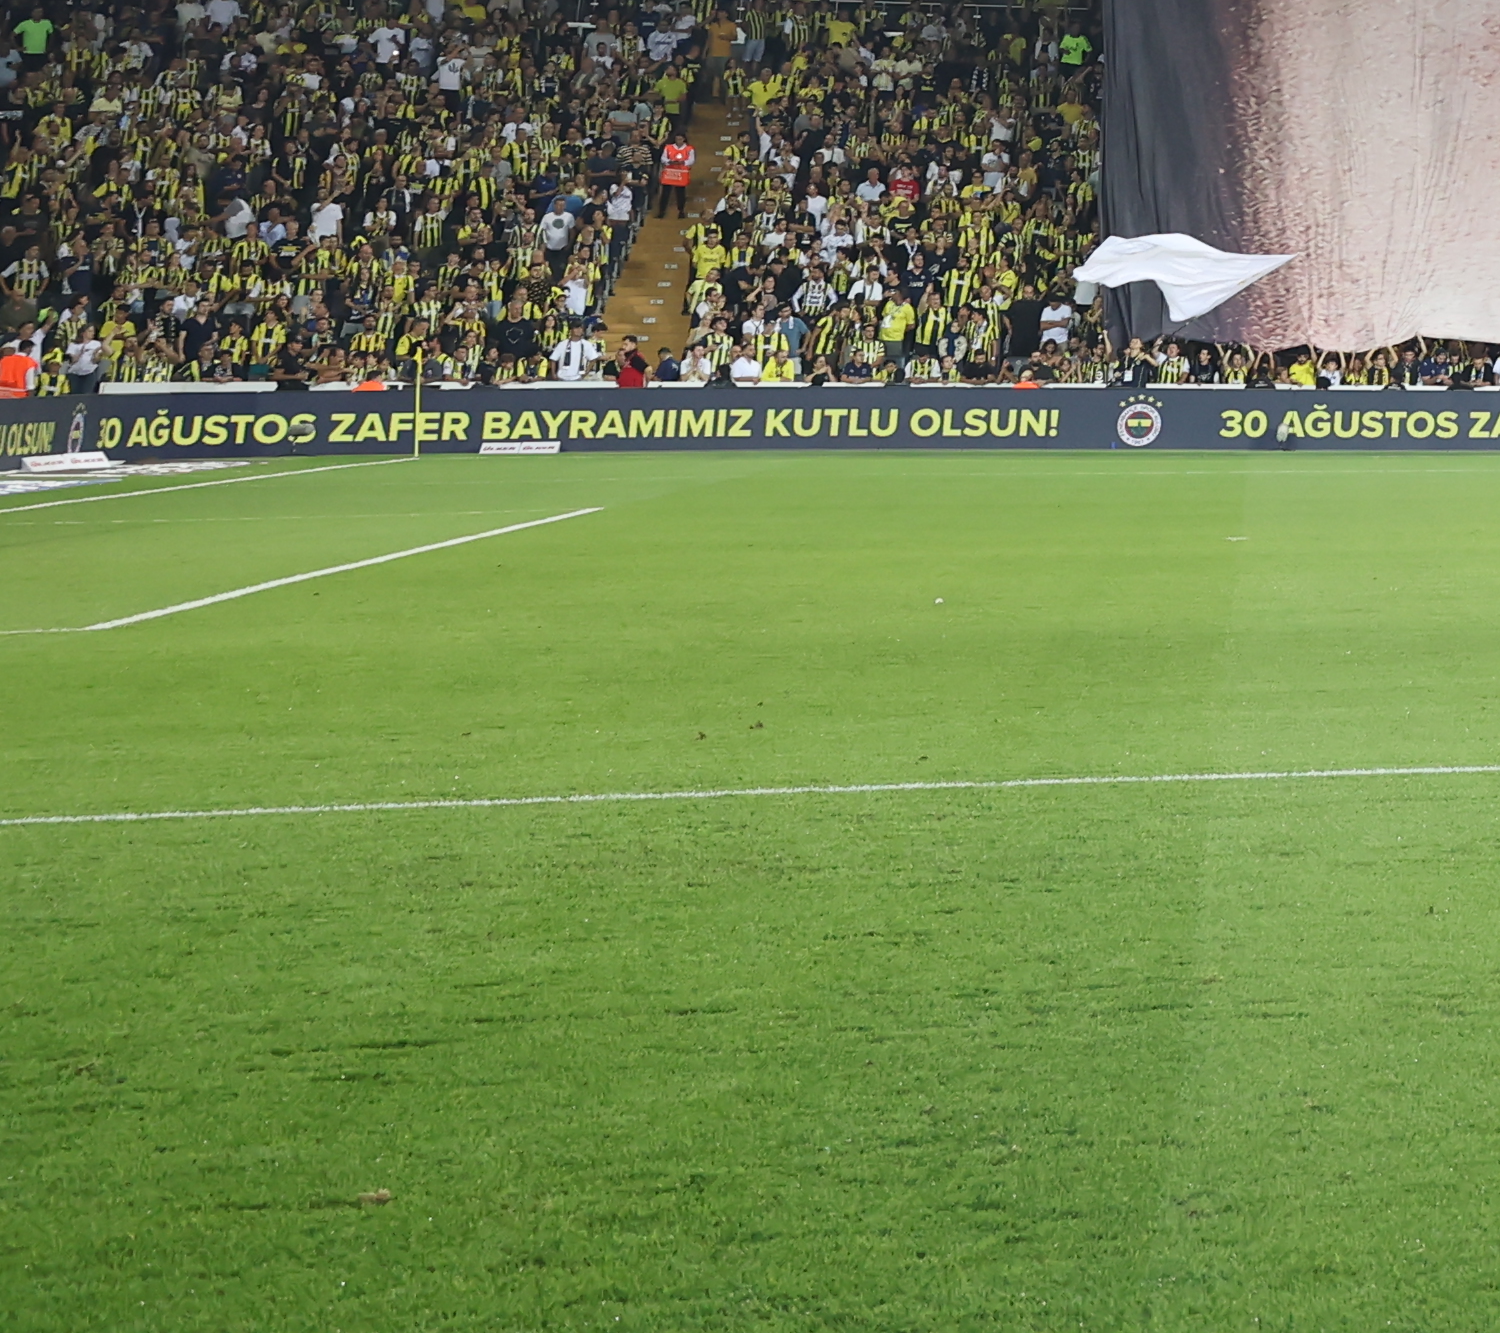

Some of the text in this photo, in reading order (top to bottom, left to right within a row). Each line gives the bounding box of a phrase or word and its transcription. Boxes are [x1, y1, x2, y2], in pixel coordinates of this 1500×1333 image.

[126, 407, 317, 449] AĞUSTOS
[328, 410, 470, 443] ZAFER
[481, 408, 753, 440] BAYRAMIMIZ
[764, 407, 899, 438] KUTLU
[909, 408, 1061, 438] OLSUN!
[1219, 409, 1268, 438] 30
[1279, 403, 1459, 439] AĞUSTOS
